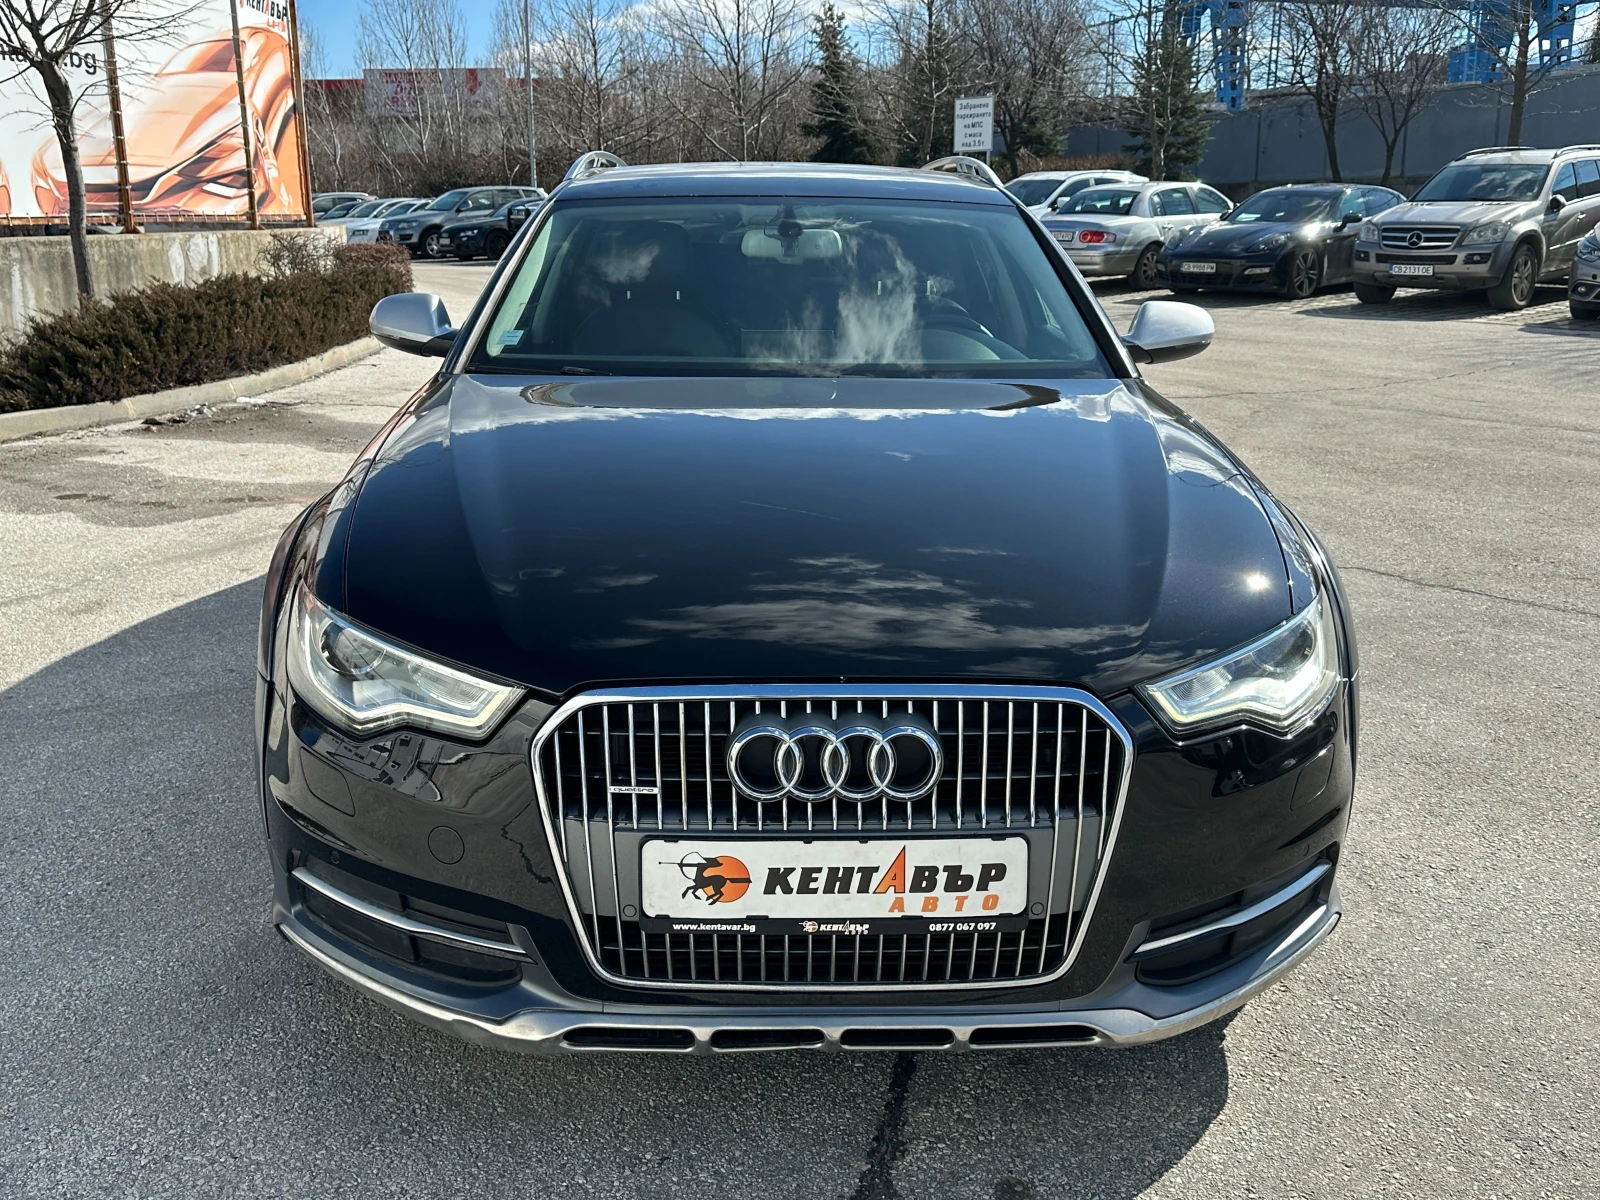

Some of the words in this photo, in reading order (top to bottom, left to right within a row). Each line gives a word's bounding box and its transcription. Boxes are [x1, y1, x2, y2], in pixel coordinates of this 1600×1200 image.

[959, 102, 989, 110] Забранено
[956, 112, 991, 120] паркирането
[1403, 266, 1420, 274] 2131
[763, 845, 1007, 895] КЕНТАВЪР
[888, 894, 1000, 912] АВТО
[672, 923, 756, 933] www.kentavar.bg
[929, 923, 954, 931] 0877
[956, 922, 975, 931] 067
[977, 922, 997, 930] 097
